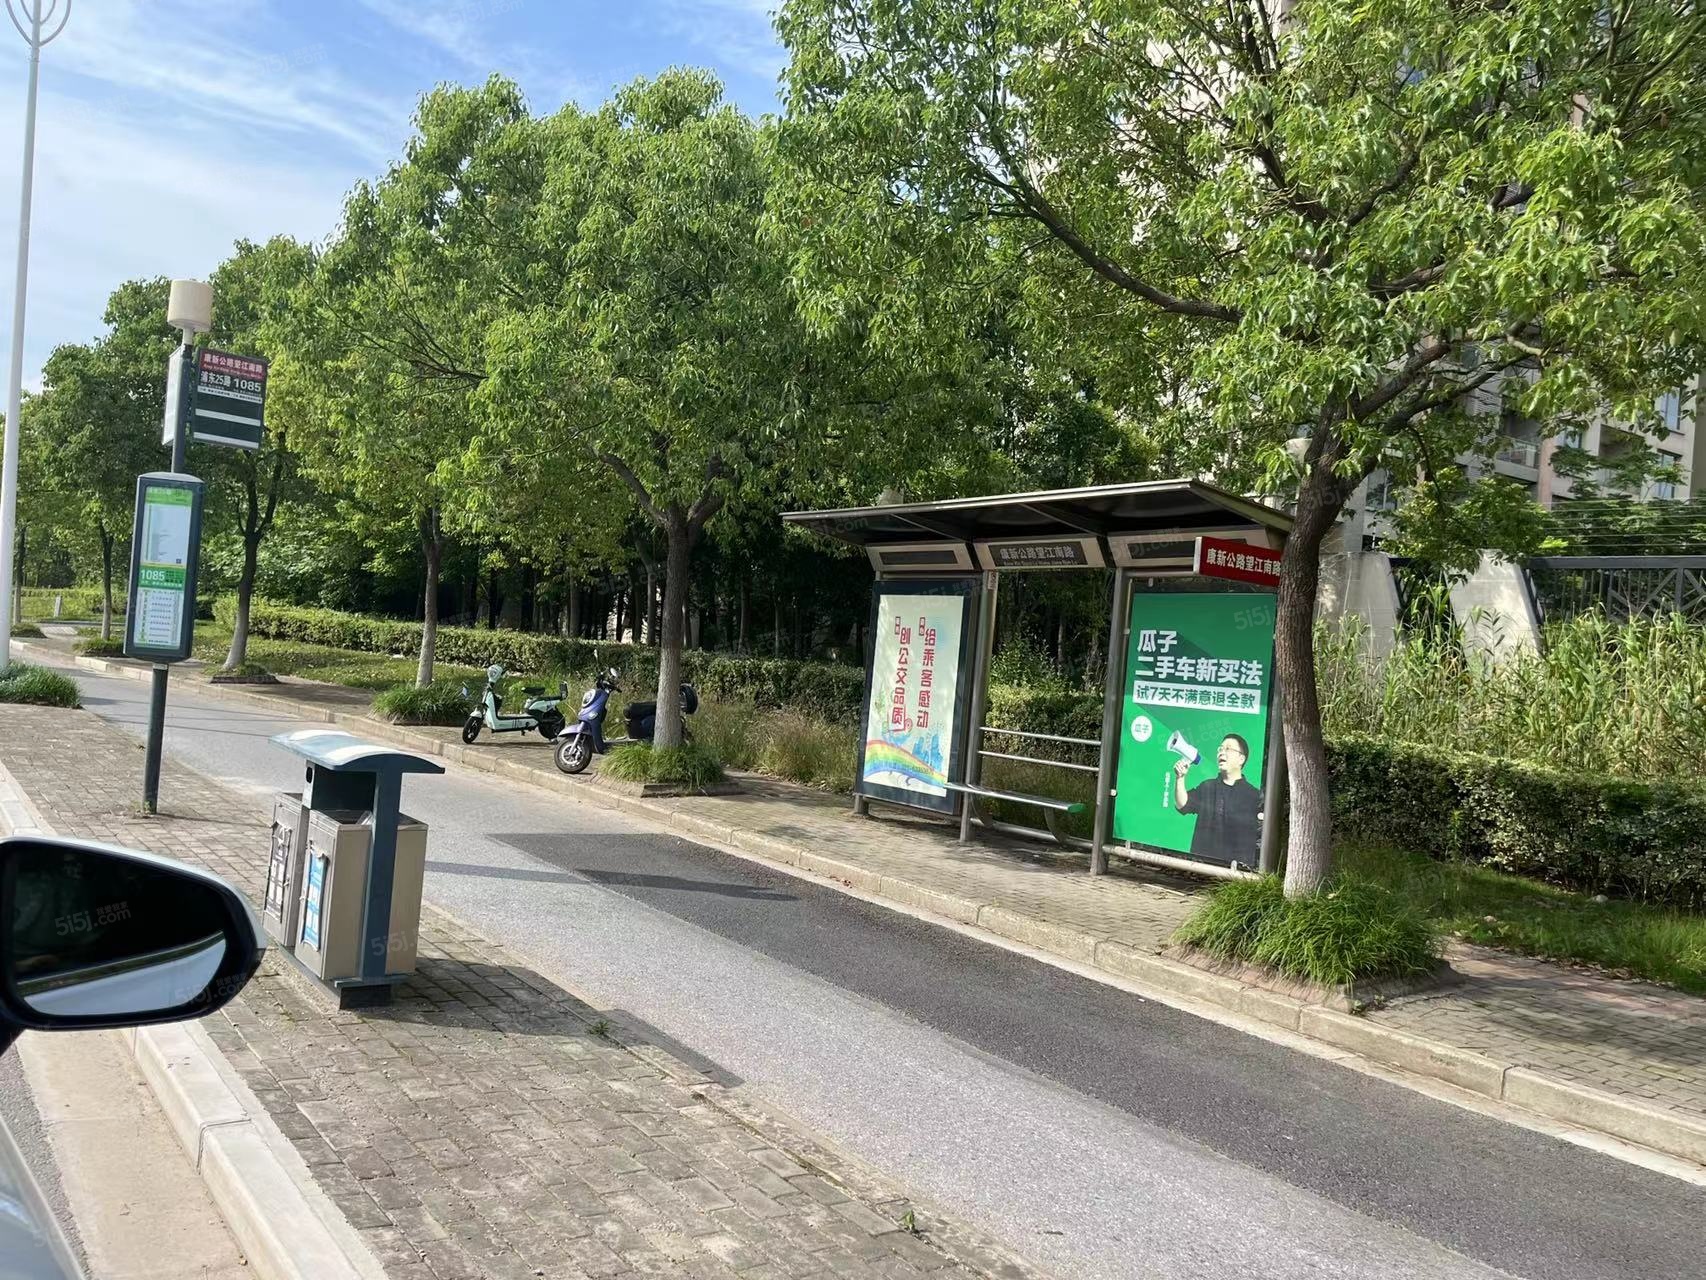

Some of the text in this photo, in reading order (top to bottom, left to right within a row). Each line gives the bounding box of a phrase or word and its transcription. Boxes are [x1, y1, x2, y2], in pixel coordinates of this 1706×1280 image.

[233, 377, 262, 392] 1085
[999, 546, 1075, 560] 康新公路望江南路
[1206, 548, 1281, 576] 康新公路望江南路
[140, 568, 165, 581] 1085
[1137, 629, 1178, 653] 瓜子
[1135, 655, 1263, 686] 二手车新买法
[1136, 684, 1256, 710] 试7天不满意退全款
